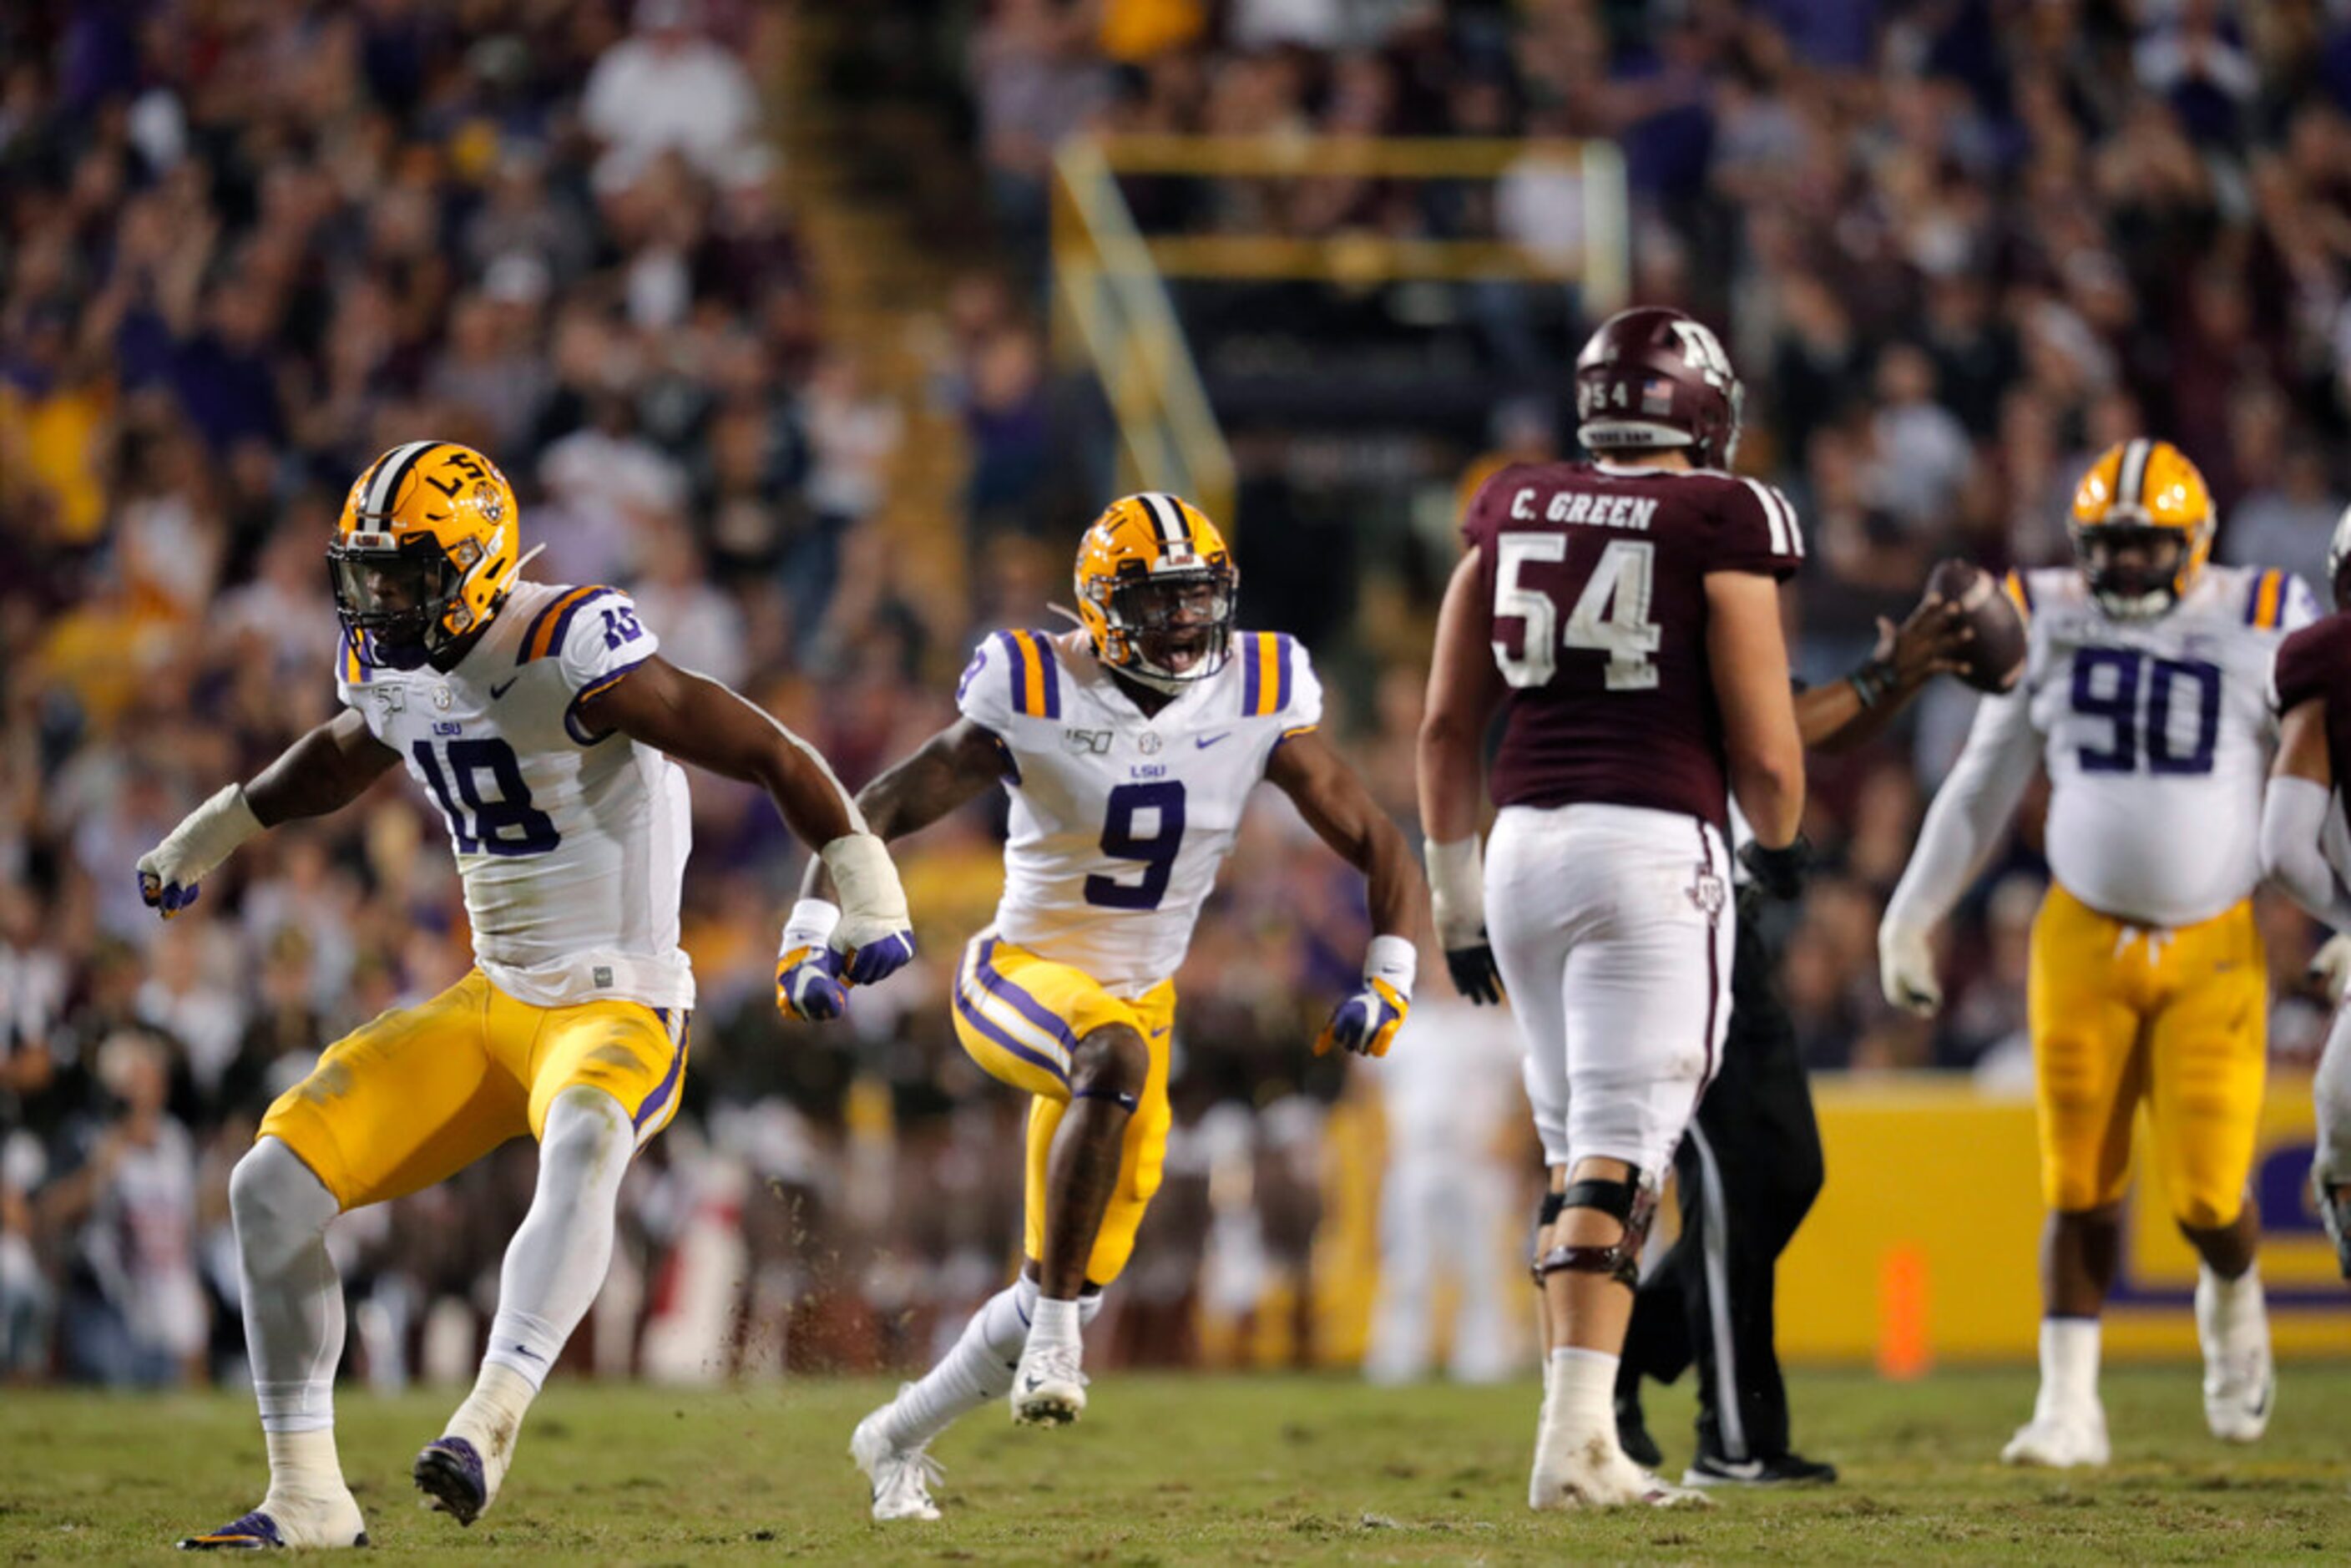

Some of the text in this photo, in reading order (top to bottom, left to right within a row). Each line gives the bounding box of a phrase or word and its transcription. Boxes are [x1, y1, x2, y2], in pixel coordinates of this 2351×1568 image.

[1591, 381, 1627, 409] 54
[1510, 488, 1659, 531] C. GREEN
[1491, 531, 1661, 690] 54
[432, 721, 463, 736] LSU
[2071, 645, 2222, 776] 90
[412, 737, 563, 856] 18
[1130, 764, 1167, 778] LSU
[1083, 779, 1186, 911] 9
